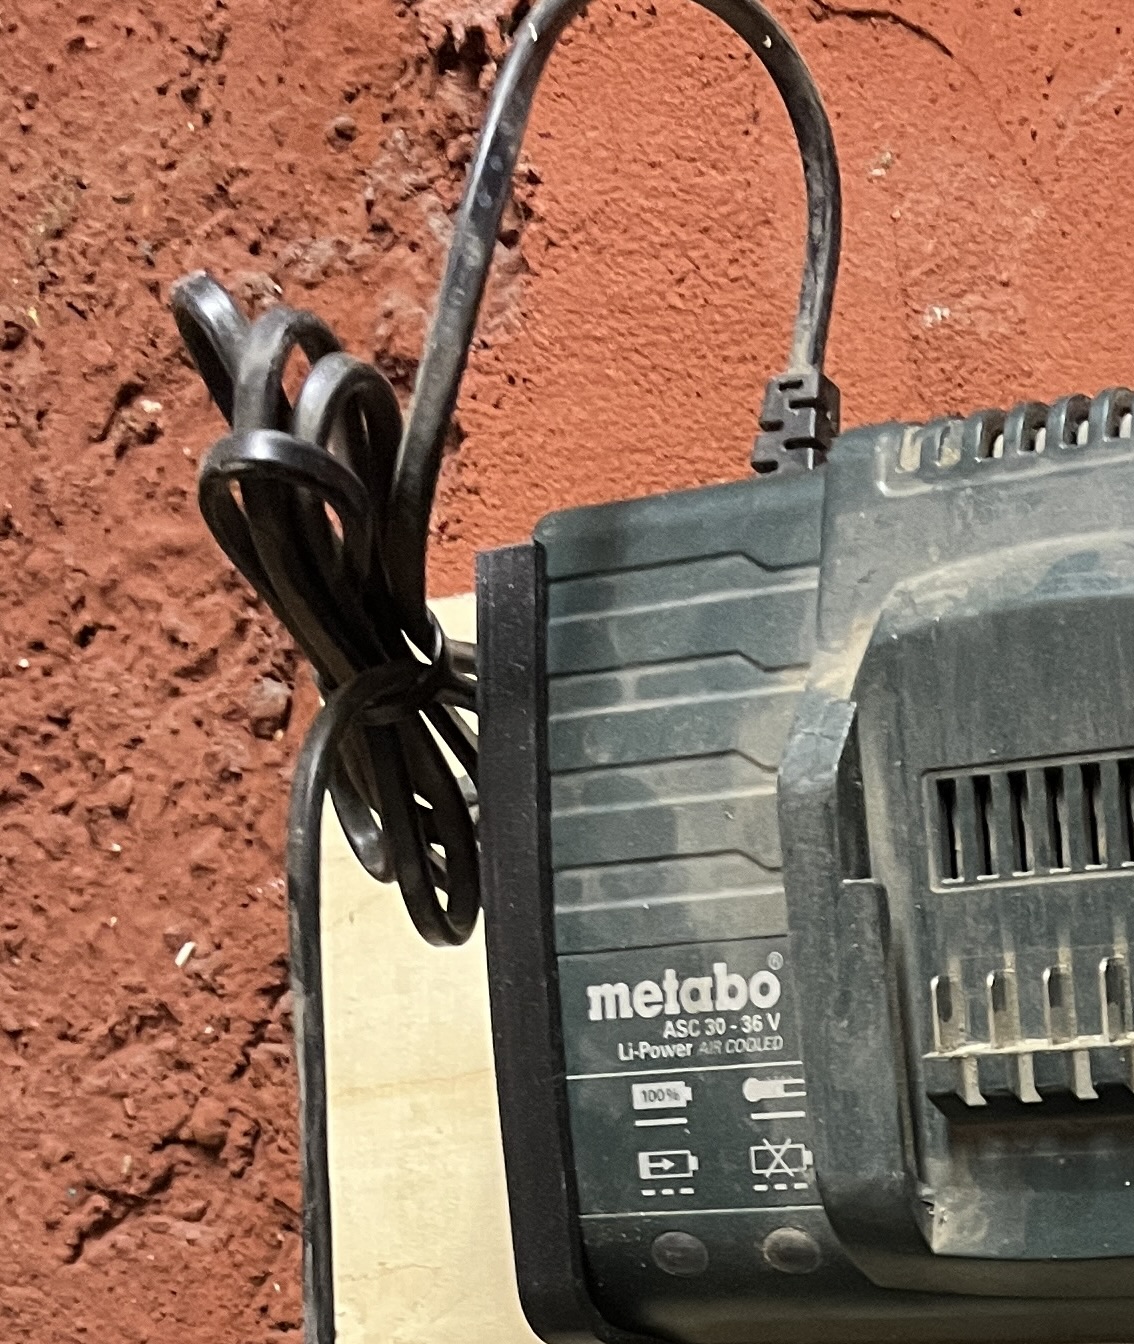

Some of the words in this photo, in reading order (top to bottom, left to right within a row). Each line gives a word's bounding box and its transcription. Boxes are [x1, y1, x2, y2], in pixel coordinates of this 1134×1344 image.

[586, 962, 781, 1021] metabo
[662, 1018, 700, 1039] ASC
[704, 1017, 726, 1036] 30
[740, 1014, 763, 1034] 36
[766, 1012, 781, 1030] V
[617, 1041, 693, 1061] Li-Power
[699, 1038, 722, 1055] AIR
[725, 1035, 784, 1054] COOLED
[640, 1087, 681, 1104] 100%
